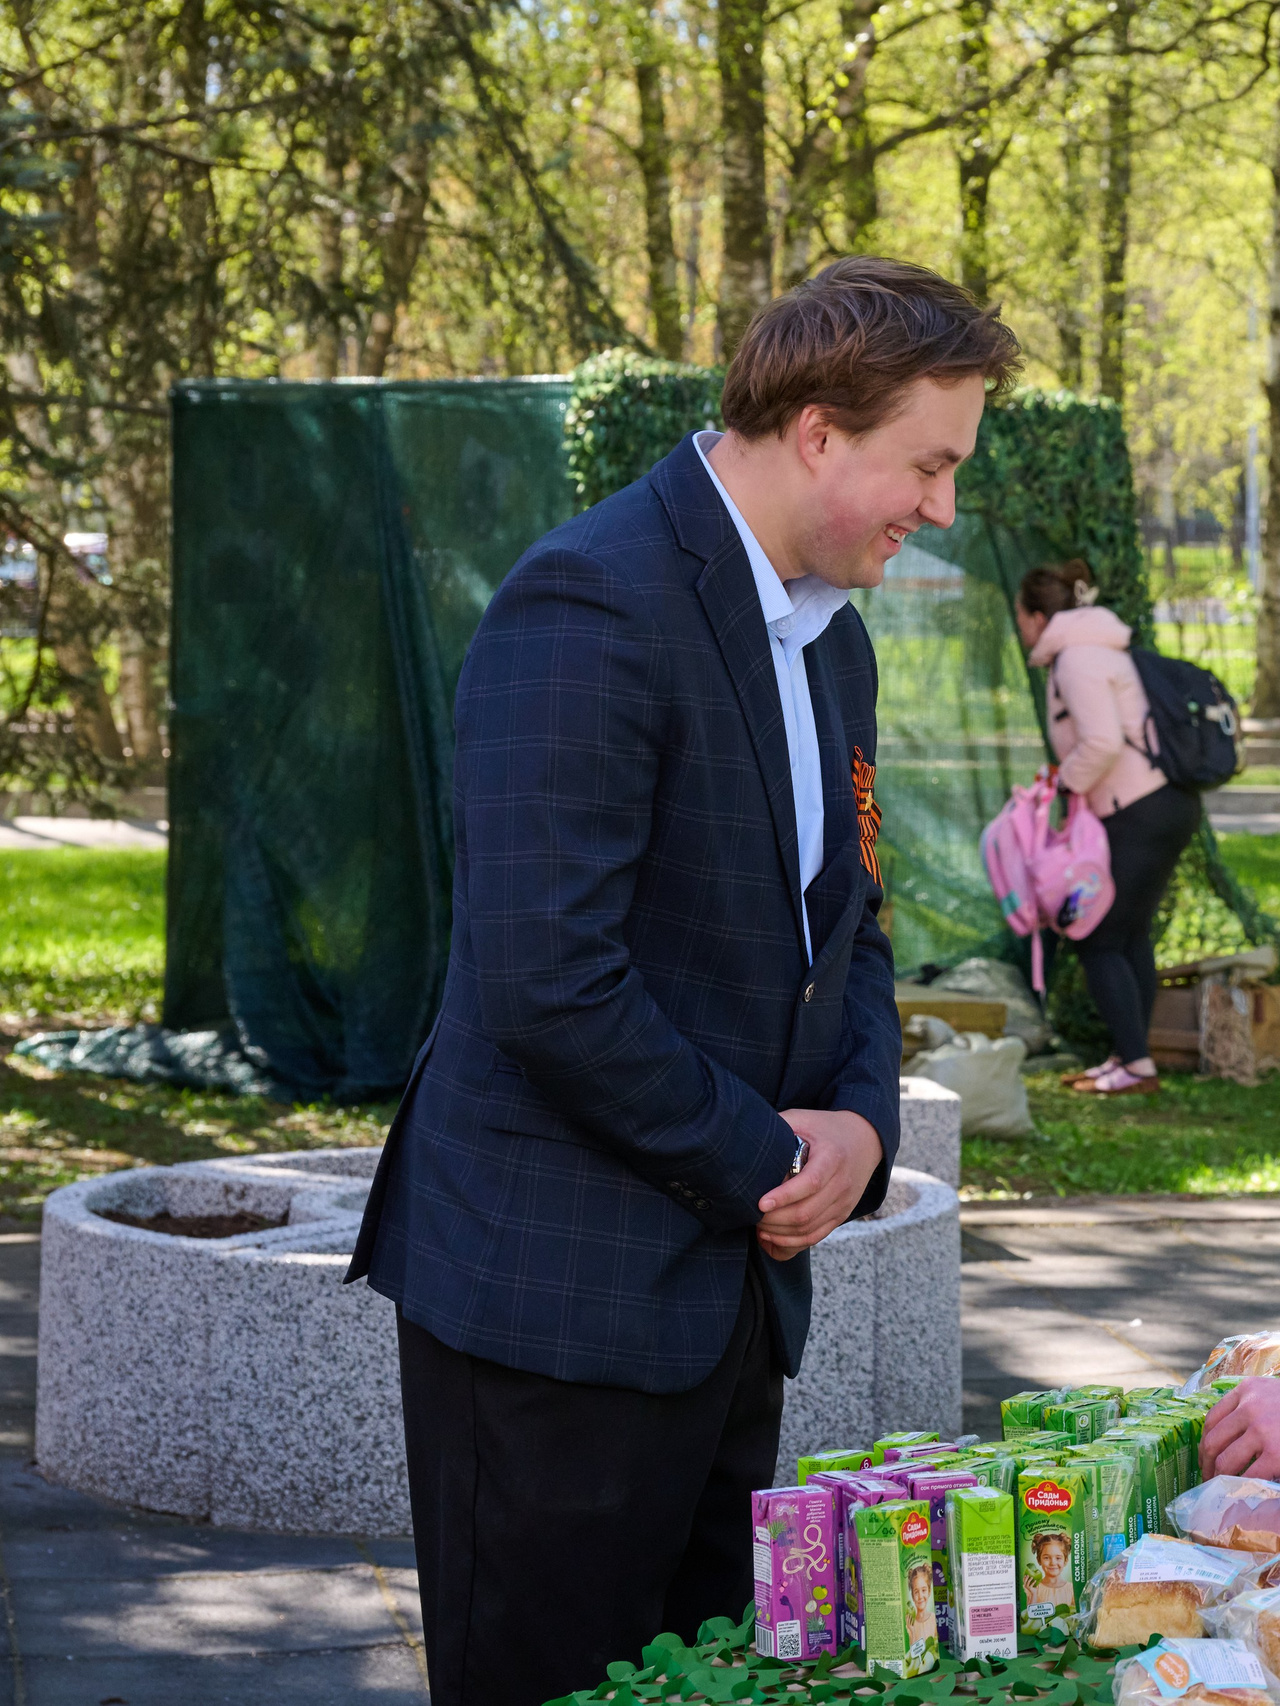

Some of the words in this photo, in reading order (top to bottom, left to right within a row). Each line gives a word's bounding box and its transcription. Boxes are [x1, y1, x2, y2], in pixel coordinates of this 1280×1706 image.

[1037, 1491, 1060, 1500] Сады
[1028, 1497, 1069, 1507] Придонья
[907, 1523, 921, 1532] Сады
[903, 1528, 928, 1541] Придонья
